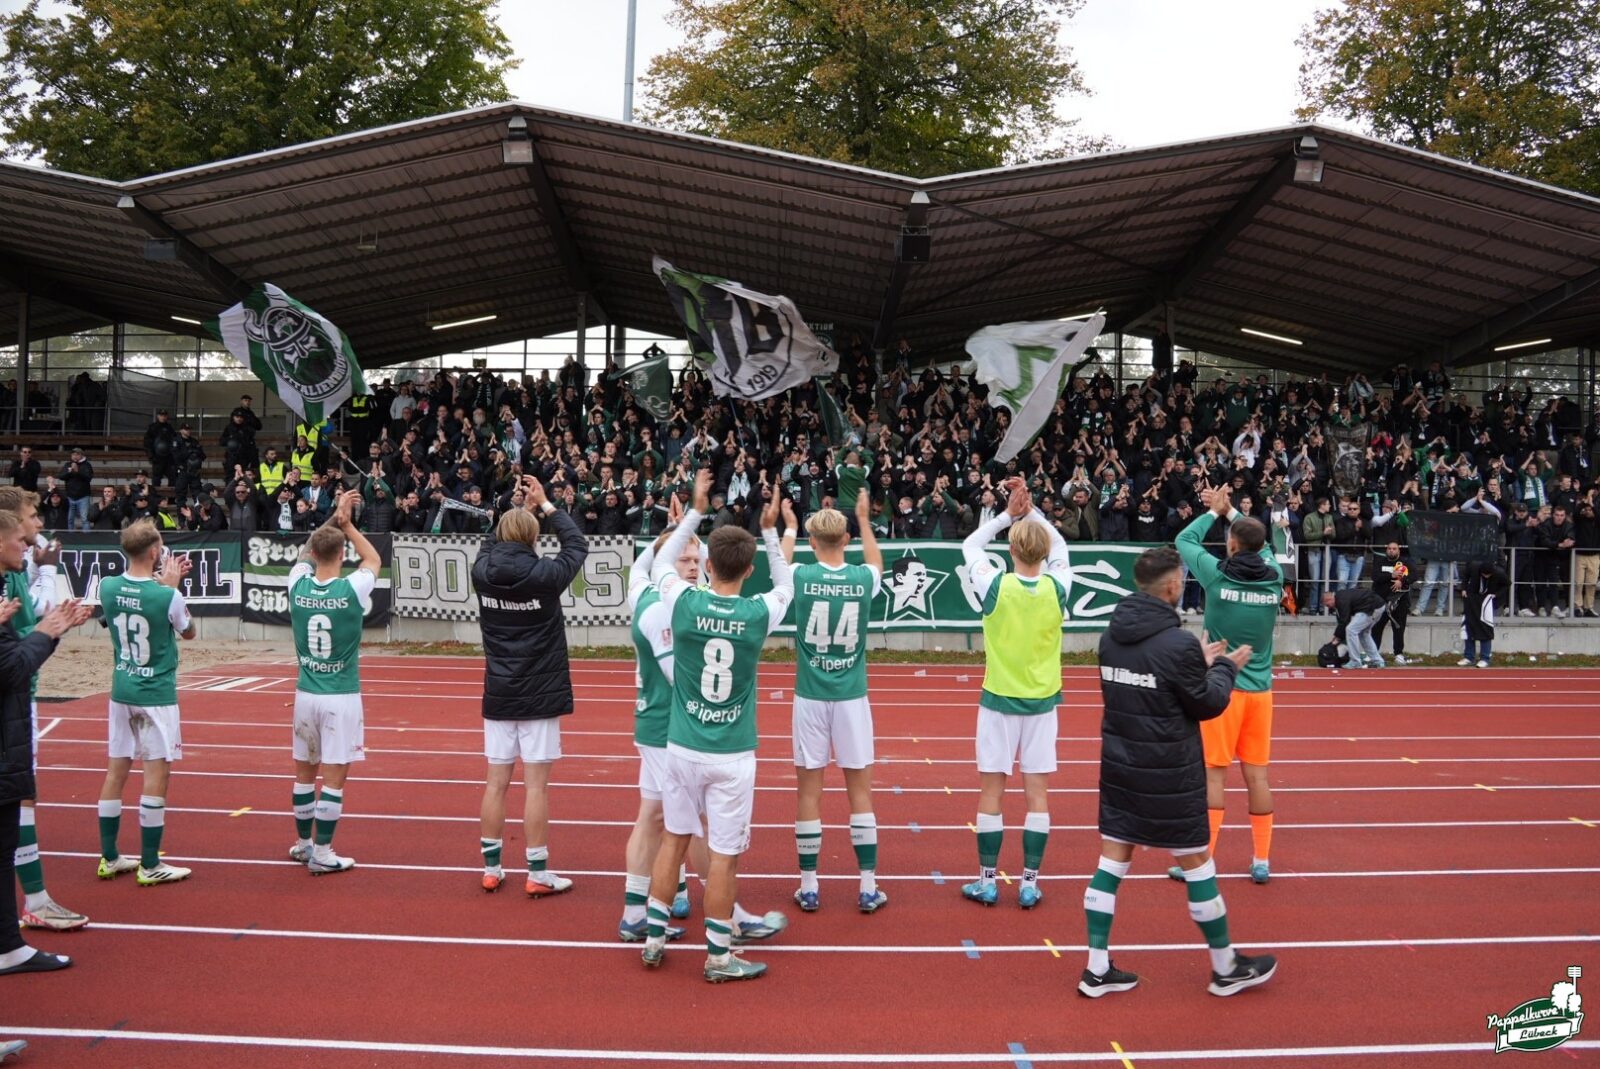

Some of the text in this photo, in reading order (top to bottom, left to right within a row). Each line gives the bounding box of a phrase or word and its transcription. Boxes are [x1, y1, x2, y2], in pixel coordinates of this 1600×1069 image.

[747, 364, 778, 391] 1919
[803, 583, 865, 597] LEHNFELD
[1220, 588, 1278, 605] VfB Lübeck
[116, 595, 143, 611] THIEL
[295, 595, 349, 609] GEERKENS
[481, 595, 541, 611] VfB Lübeck
[696, 616, 746, 635] WULFF
[804, 601, 860, 653] 44
[113, 612, 150, 666] 13
[307, 614, 332, 659] 6
[309, 658, 344, 673] iperdi
[701, 638, 734, 703] 8
[1114, 667, 1157, 688] Lübeck
[698, 703, 742, 724] iperdi
